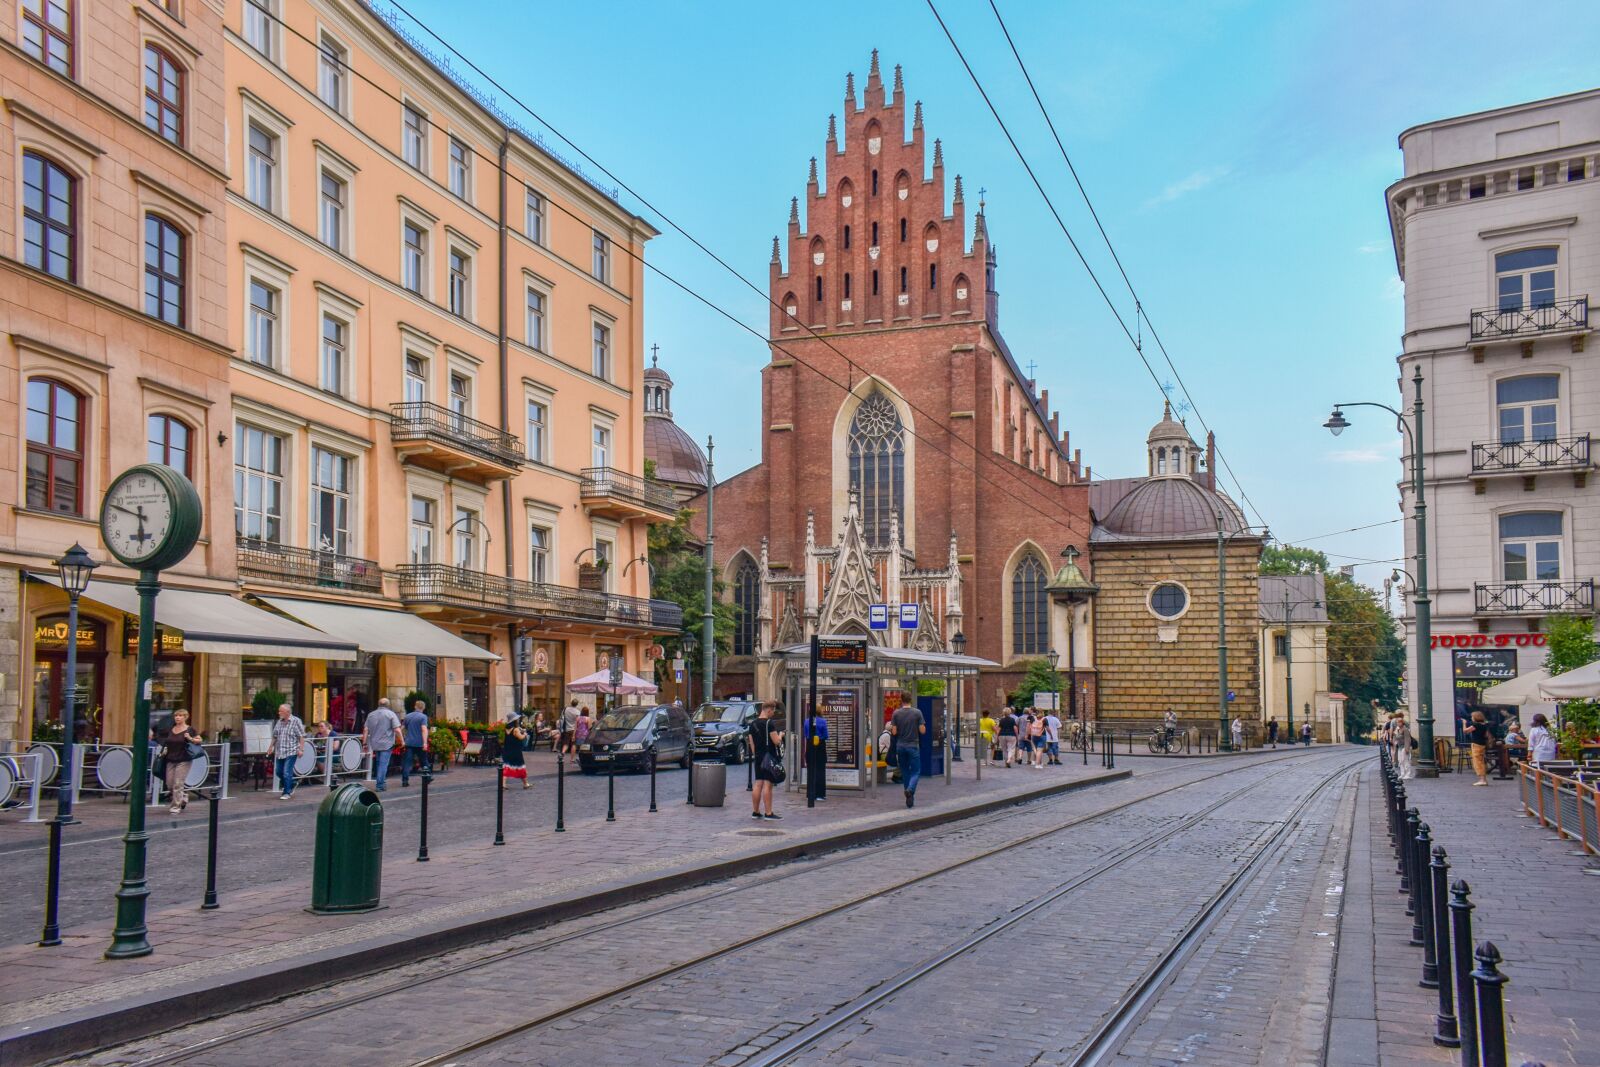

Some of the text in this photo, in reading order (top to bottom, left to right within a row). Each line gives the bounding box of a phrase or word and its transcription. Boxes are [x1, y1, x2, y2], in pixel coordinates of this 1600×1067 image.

[138, 479, 146, 488] 12
[126, 484, 132, 494] 11
[116, 497, 124, 505] 10
[112, 514, 118, 522] 9
[164, 510, 170, 520] 3
[115, 530, 120, 540] 8
[160, 527, 165, 536] 4
[125, 541, 130, 550] 7
[150, 540, 156, 549] 5
[69, 629, 95, 640] EEF
[1494, 634, 1549, 647] FOO
[1480, 669, 1515, 677] Grill
